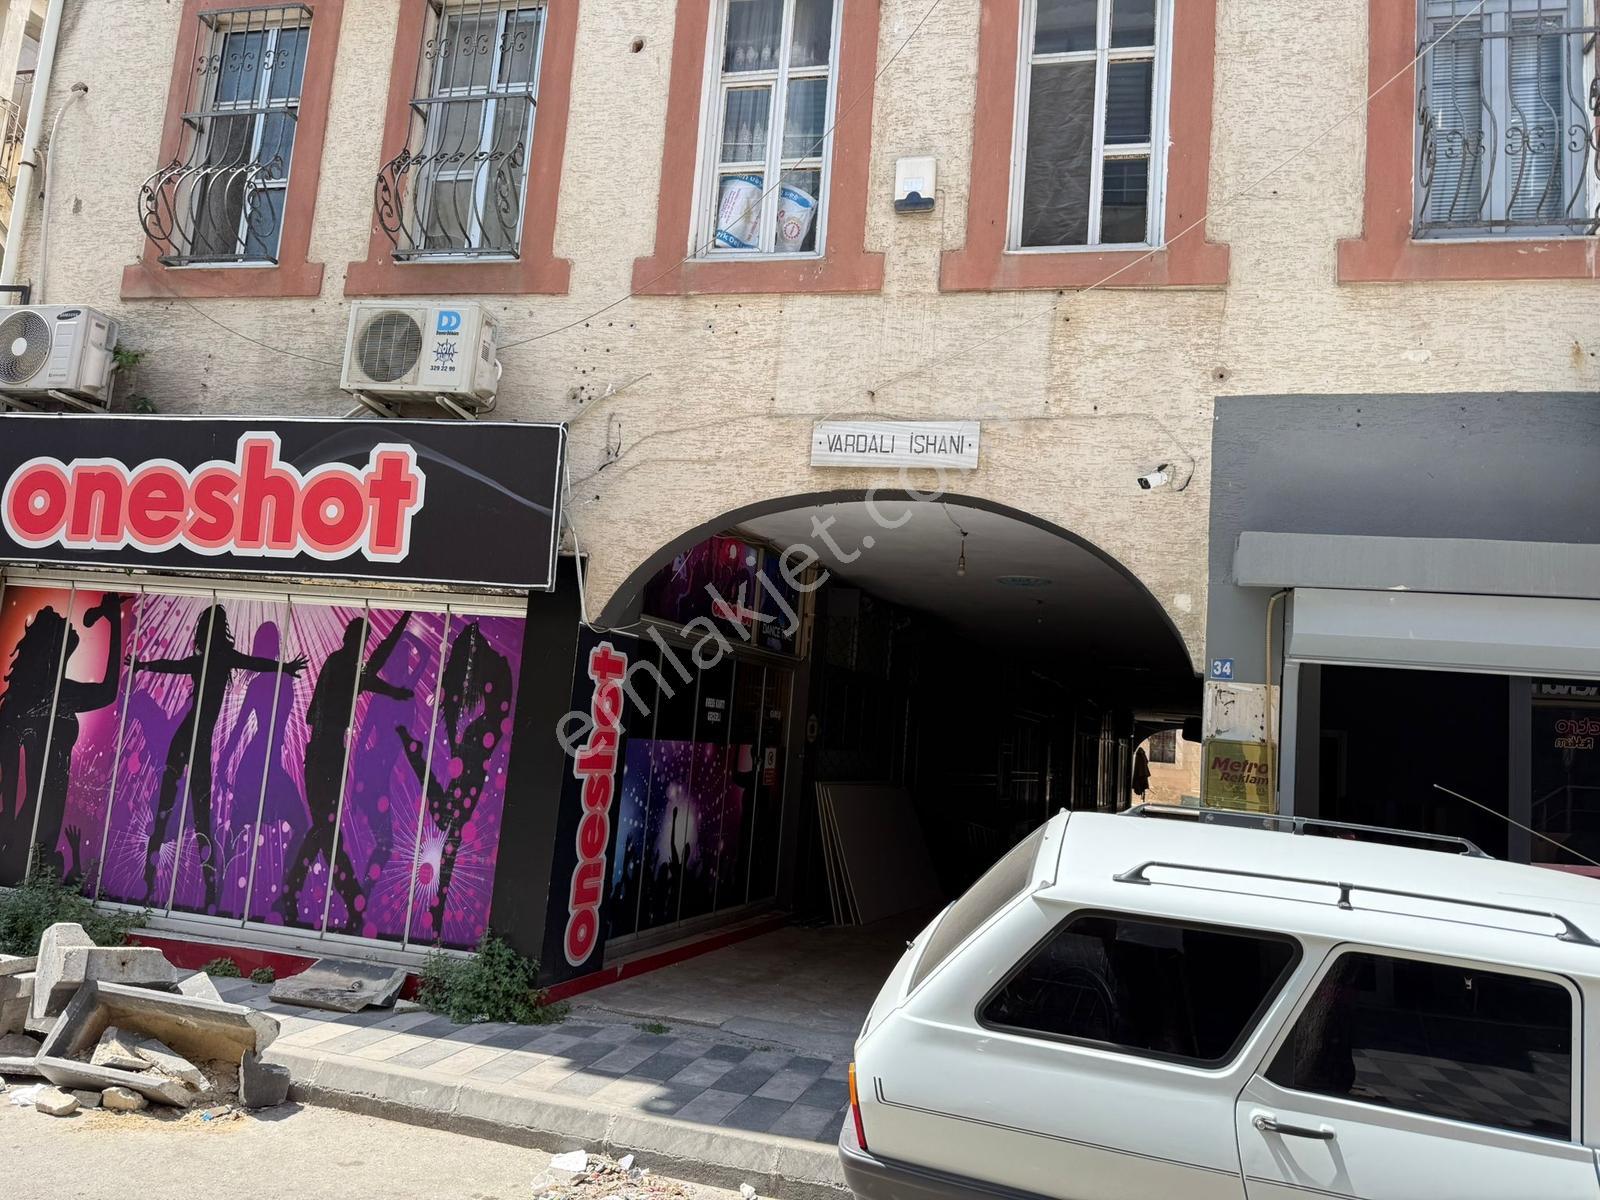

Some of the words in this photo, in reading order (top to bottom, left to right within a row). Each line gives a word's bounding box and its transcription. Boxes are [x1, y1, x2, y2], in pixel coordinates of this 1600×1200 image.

[827, 434, 895, 454] VARDALI
[3, 431, 425, 563] oneshot
[1213, 661, 1231, 675] 34
[1212, 756, 1268, 775] Metro
[1220, 771, 1269, 786] Reklam
[565, 641, 629, 968] oneshot
